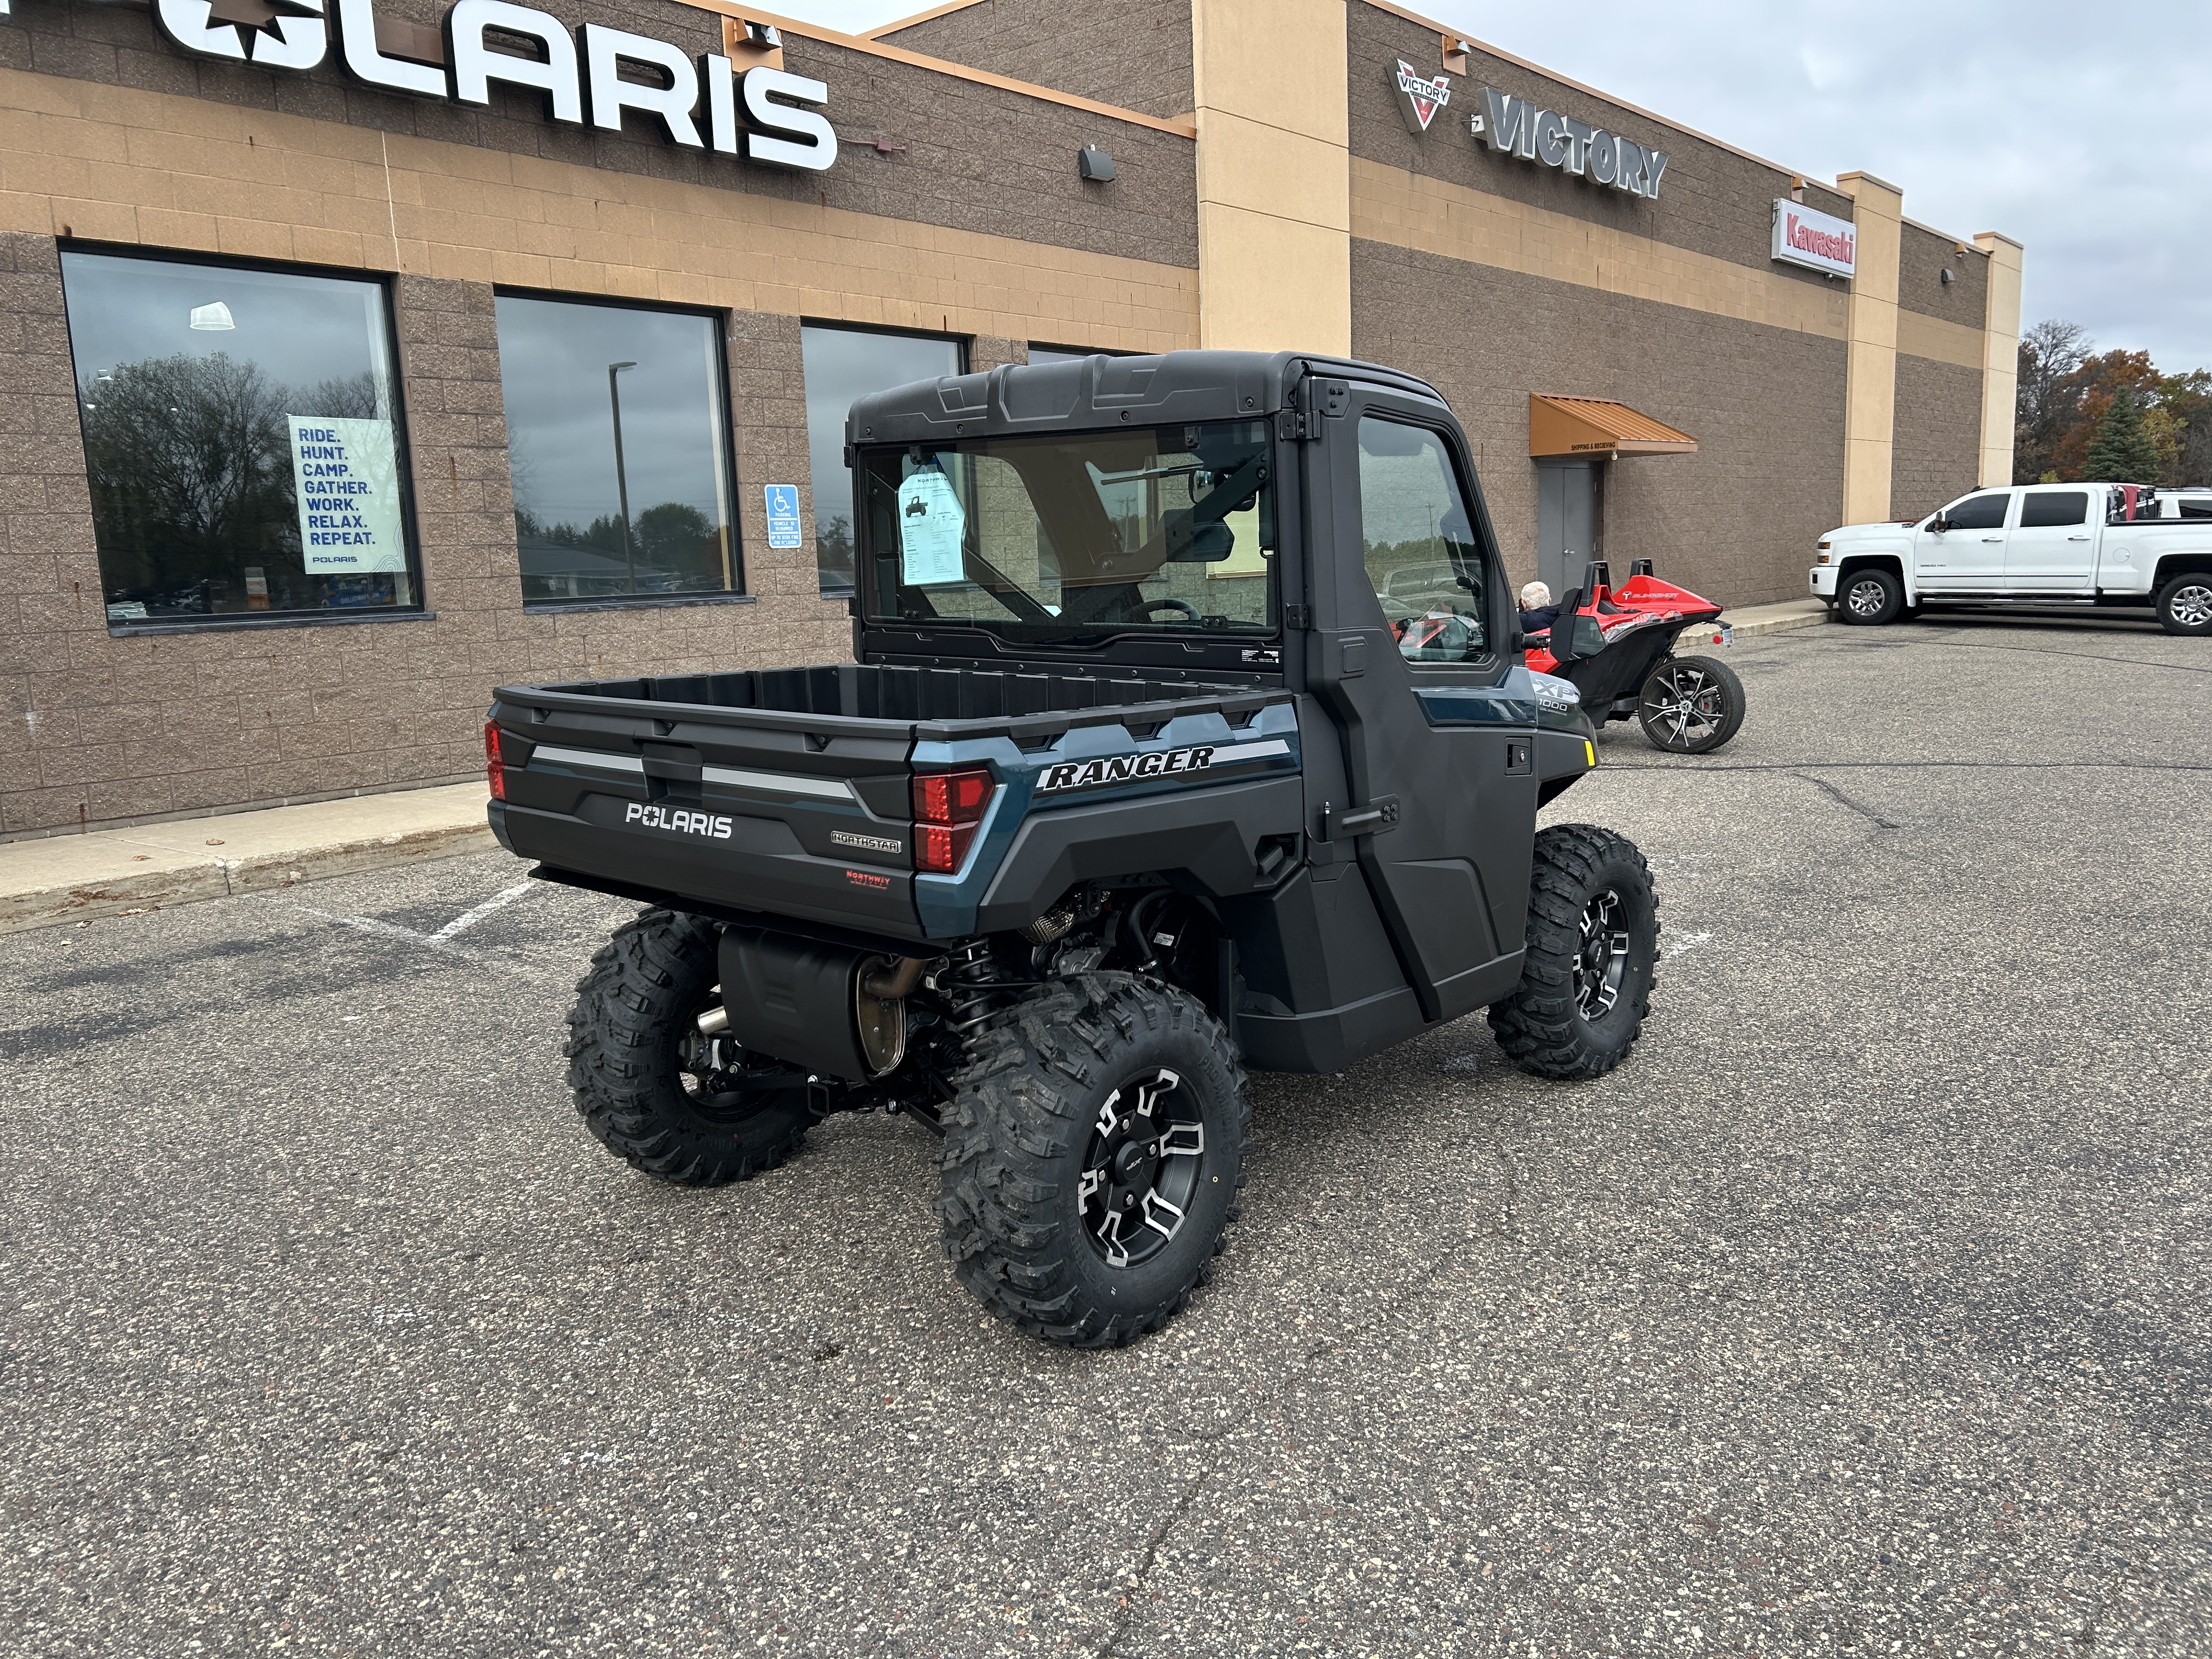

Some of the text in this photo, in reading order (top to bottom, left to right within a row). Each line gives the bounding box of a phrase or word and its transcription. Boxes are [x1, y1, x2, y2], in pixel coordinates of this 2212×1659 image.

[0, 0, 838, 170] OLARIS
[1401, 76, 1447, 101] VICTORY
[1478, 87, 1669, 199] VICTORY
[1787, 212, 1853, 264] Kawasaki
[298, 428, 341, 443] RIDE.
[301, 445, 348, 460] HUNT.
[303, 464, 353, 477] CAMP.
[304, 481, 372, 494] GATHER.
[306, 498, 359, 511] WORK.
[308, 515, 367, 528] RELAX.
[310, 532, 376, 545] REPEAT.
[1534, 679, 1575, 698] XP
[1539, 698, 1567, 712] 1000
[1043, 746, 1214, 791] RANGER
[625, 803, 732, 839] POLARIS
[834, 834, 896, 850] NORTHSTAR
[847, 870, 890, 884] NORTHWAY
